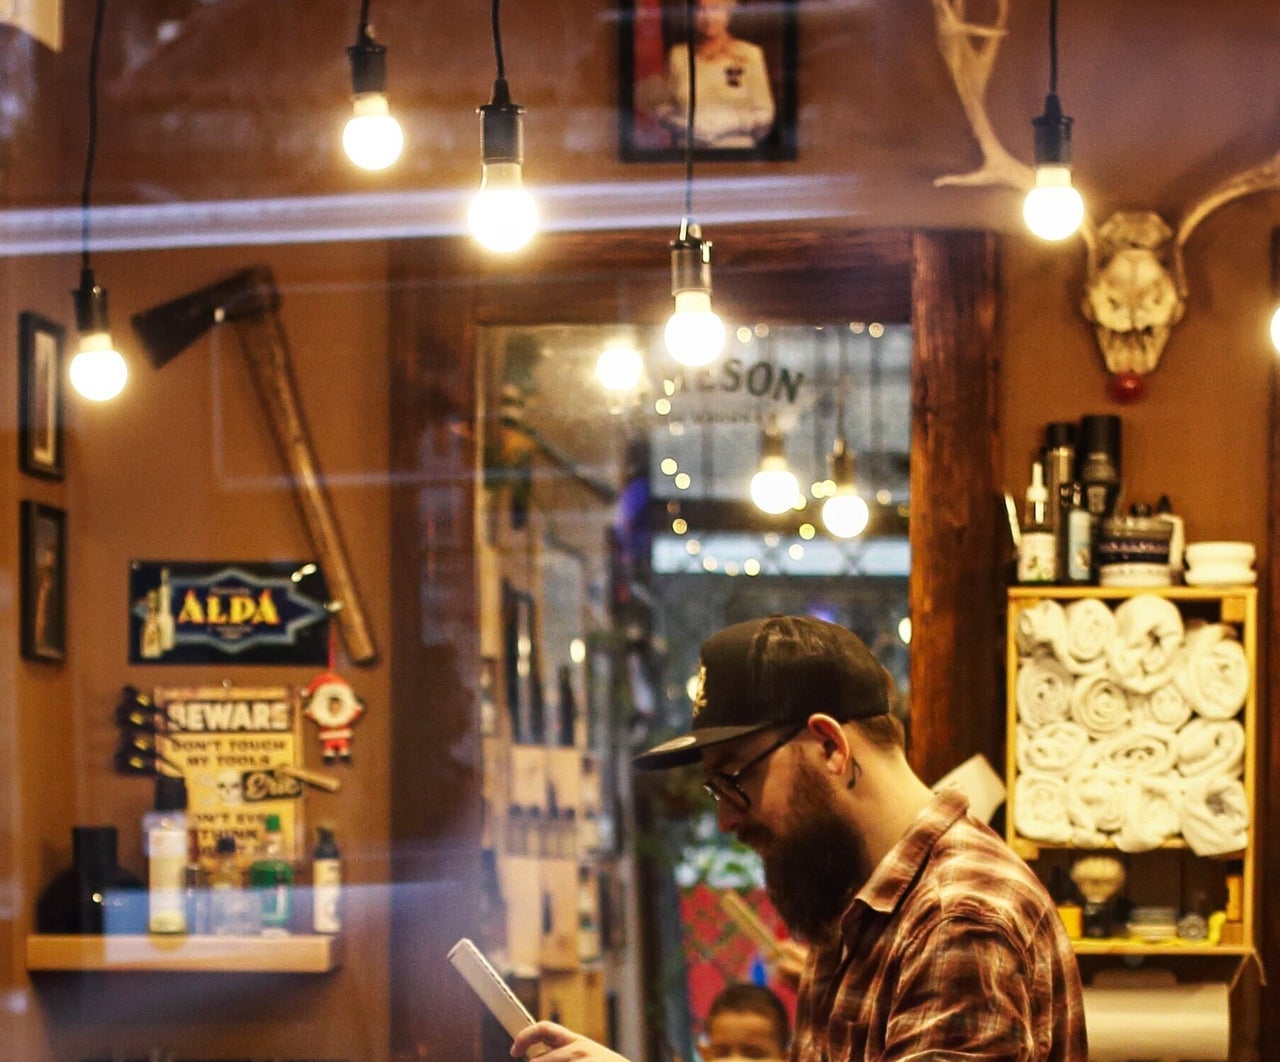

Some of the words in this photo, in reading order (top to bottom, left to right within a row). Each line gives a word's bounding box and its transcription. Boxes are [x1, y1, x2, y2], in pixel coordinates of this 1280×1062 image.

[177, 588, 282, 625] ALPA
[167, 702, 289, 730] BEWARE
[230, 741, 285, 750] TOUCH
[187, 756, 209, 767] MY
[217, 756, 270, 766] TOOLS
